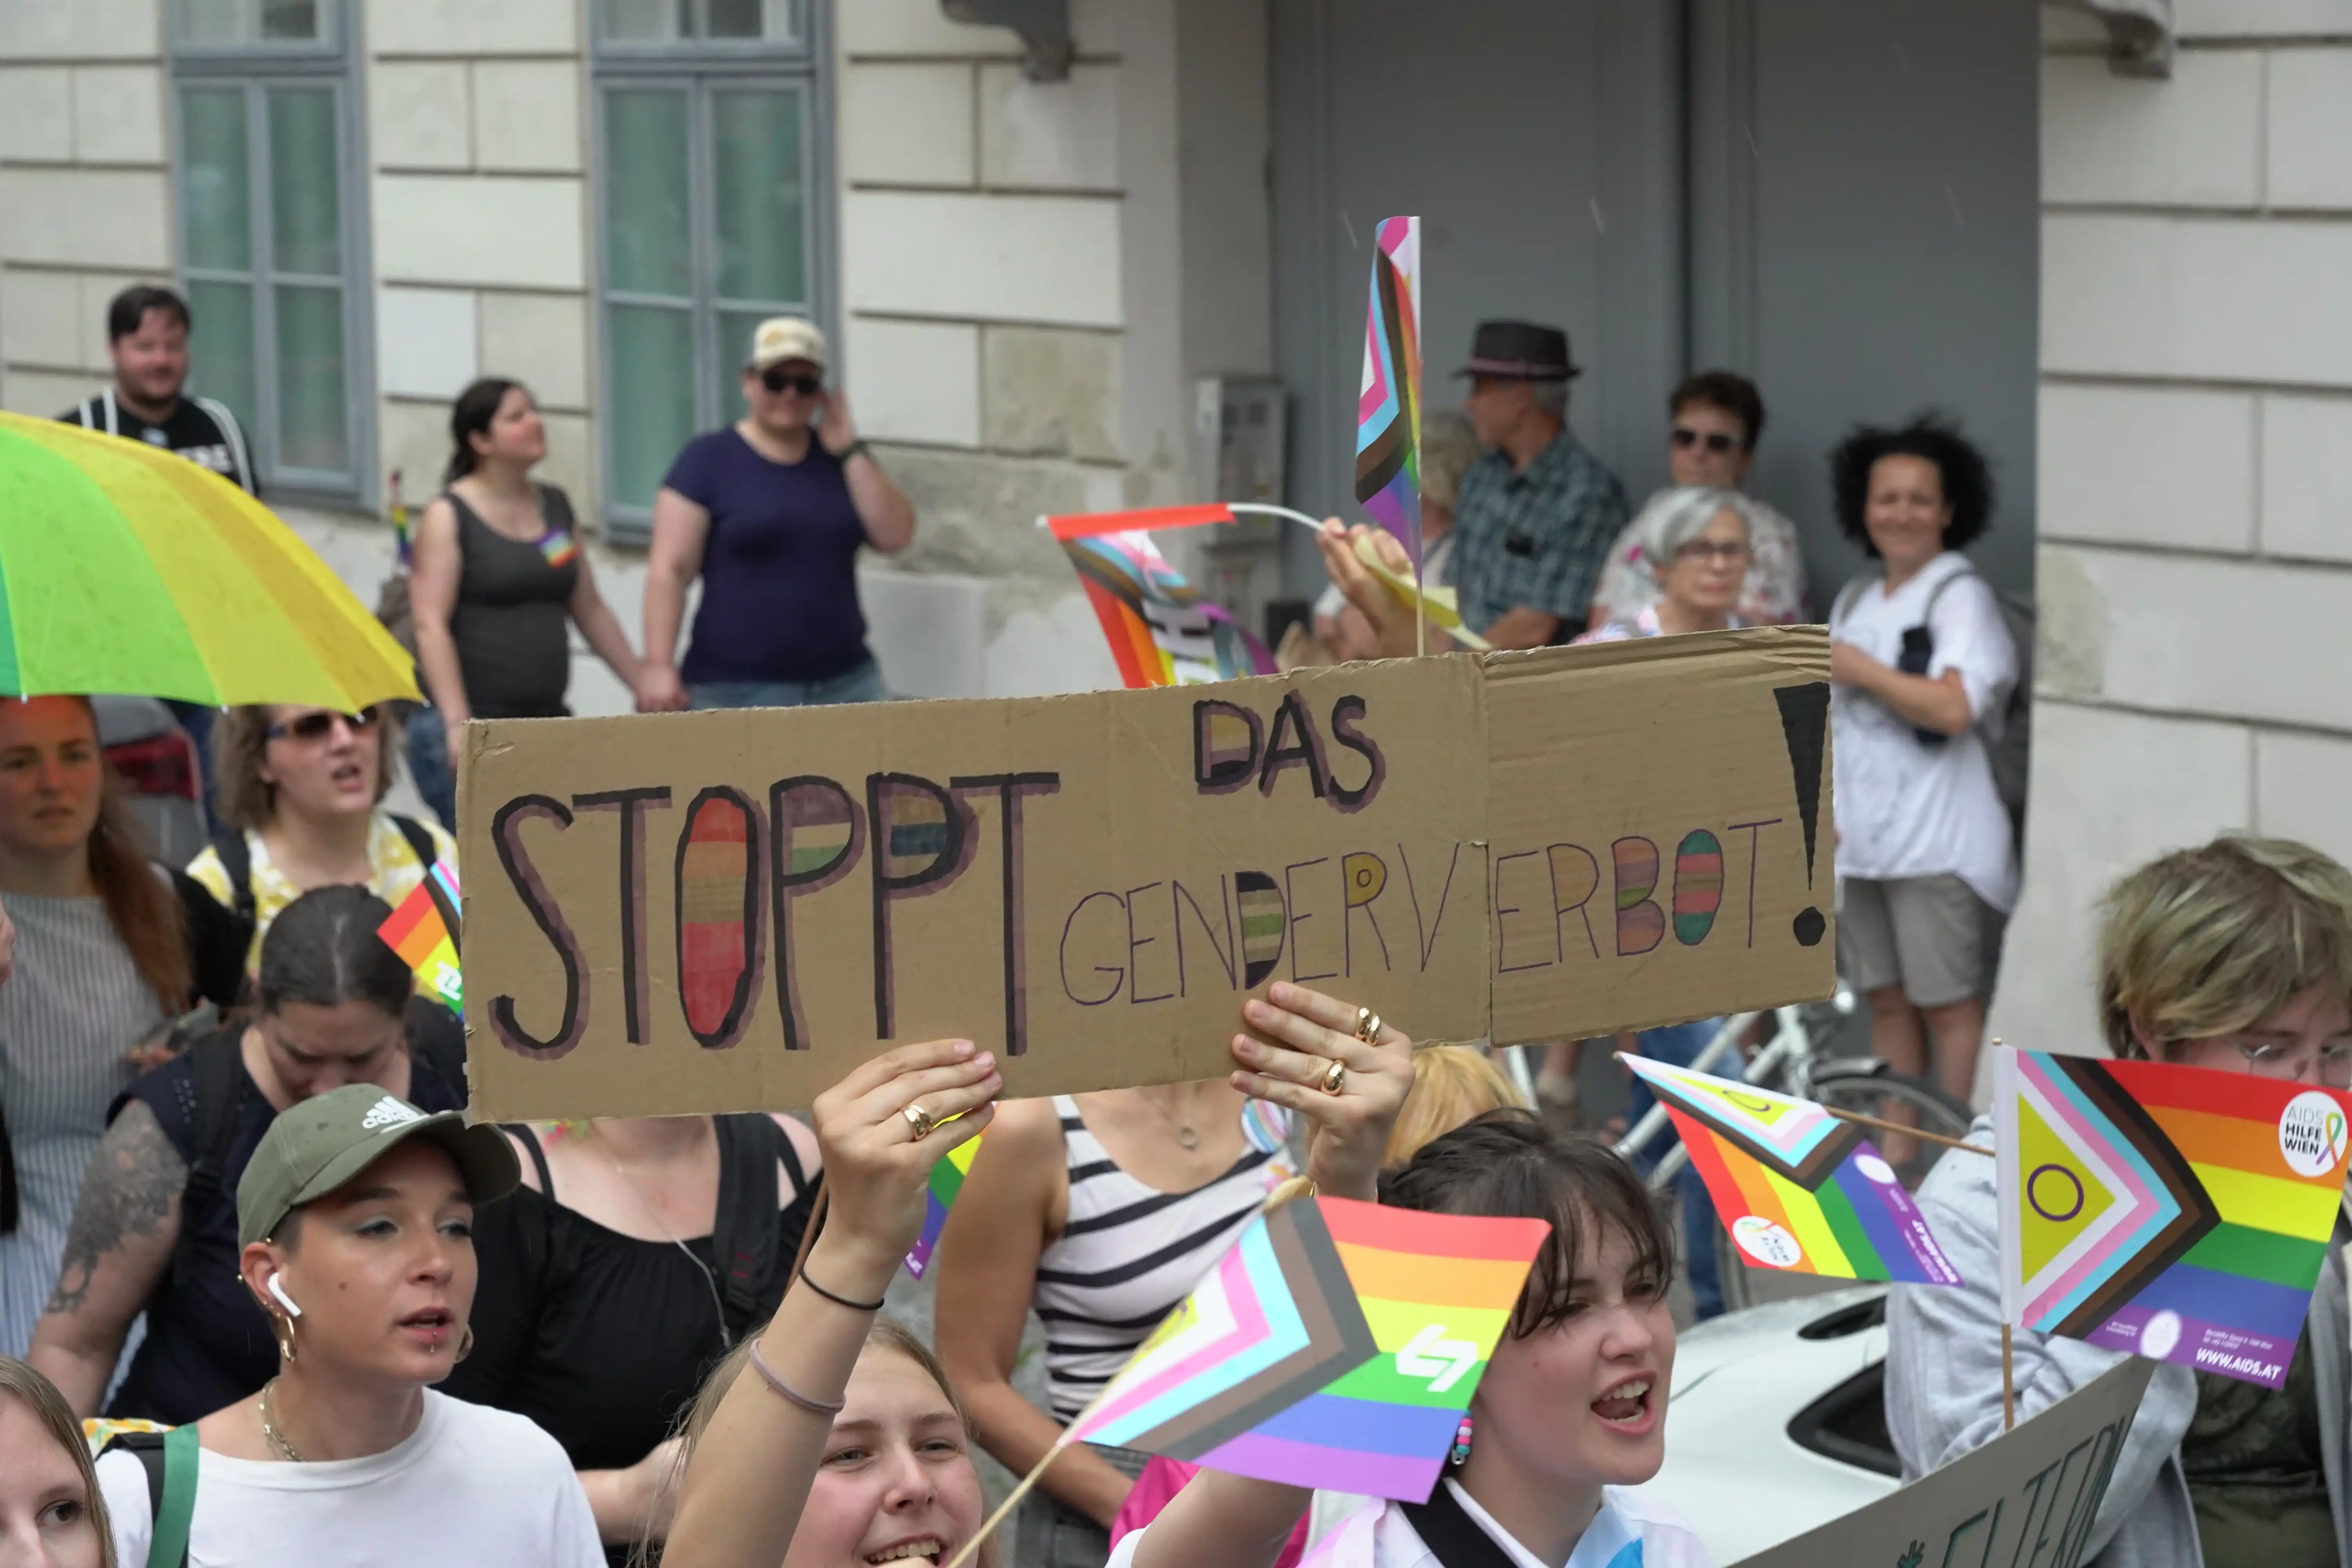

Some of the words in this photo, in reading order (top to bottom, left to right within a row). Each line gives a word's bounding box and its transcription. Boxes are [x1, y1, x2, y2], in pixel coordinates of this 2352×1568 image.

[1193, 689, 1386, 814] DAS
[487, 771, 1062, 1061] STOPPT
[2287, 1105, 2323, 1126] AIDS
[2286, 1121, 2322, 1142] HILFE
[2285, 1136, 2319, 1156] WIEN
[2196, 1347, 2283, 1381] WWW.AIDS.AT
